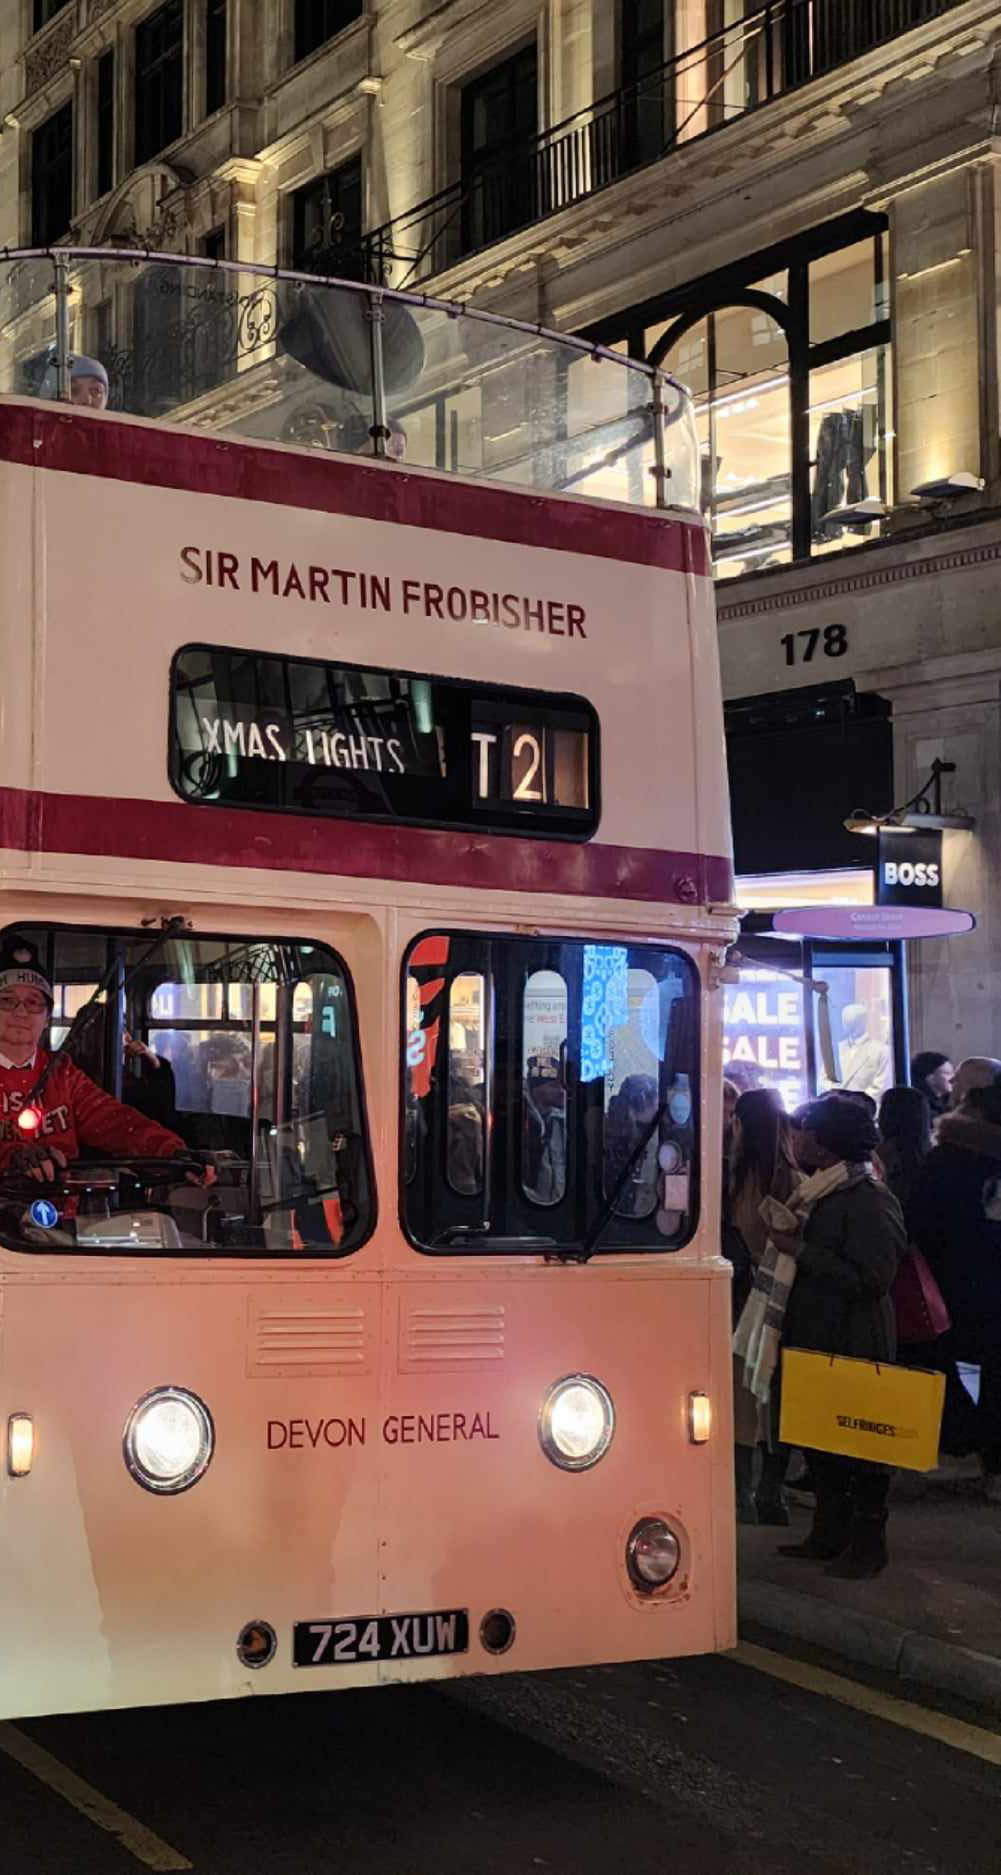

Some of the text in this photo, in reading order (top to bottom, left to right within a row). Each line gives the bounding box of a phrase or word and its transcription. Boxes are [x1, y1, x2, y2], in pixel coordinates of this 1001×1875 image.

[180, 546, 588, 639] SIR MARTIN FROBISHER
[780, 623, 849, 666] 178
[203, 717, 287, 762] XMAS
[470, 732, 542, 802] T 2
[884, 862, 940, 887] BOSS
[724, 991, 801, 1024] ALE
[267, 1412, 499, 1449] DEVON GENERAL
[309, 1614, 457, 1662] 724 XUW
